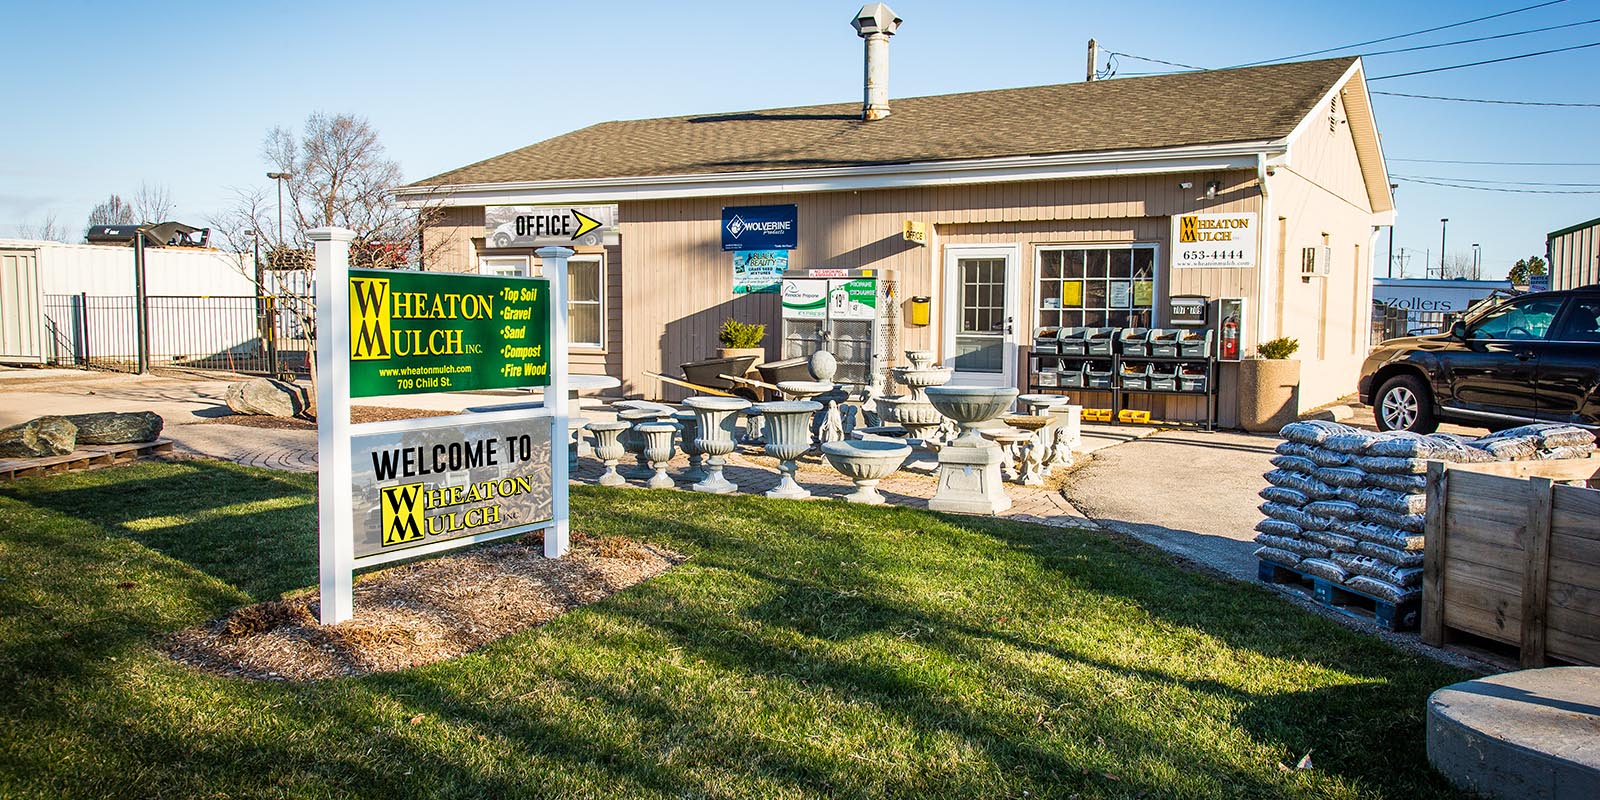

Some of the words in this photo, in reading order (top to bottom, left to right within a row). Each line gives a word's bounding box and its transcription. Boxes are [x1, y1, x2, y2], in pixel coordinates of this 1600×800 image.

[516, 215, 570, 236] OFFICE
[745, 222, 791, 231] WOLVERINE
[1182, 217, 1249, 230] WHEATON
[906, 230, 923, 240] OFFICE
[1182, 230, 1232, 241] MULCH
[1183, 250, 1243, 260] 653-4444
[351, 280, 494, 319] WHEATON
[504, 287, 519, 302] Top
[520, 288, 537, 301] Soil
[1386, 297, 1452, 311] Zollers
[504, 307, 531, 320] Gravel
[353, 319, 464, 357] MULCH
[465, 344, 483, 354] INC.
[504, 325, 526, 339] Sand
[504, 345, 541, 360] Compost
[379, 365, 472, 377] www.wheatonmulch.com
[504, 364, 522, 377] Fire
[524, 362, 547, 376] Wood
[397, 380, 413, 389] 709
[415, 377, 439, 389] Child
[440, 376, 452, 388] St.
[372, 438, 498, 481] WELCOME
[506, 434, 531, 463] TO
[383, 475, 533, 515] WHEATON
[385, 505, 501, 543] MULCH
